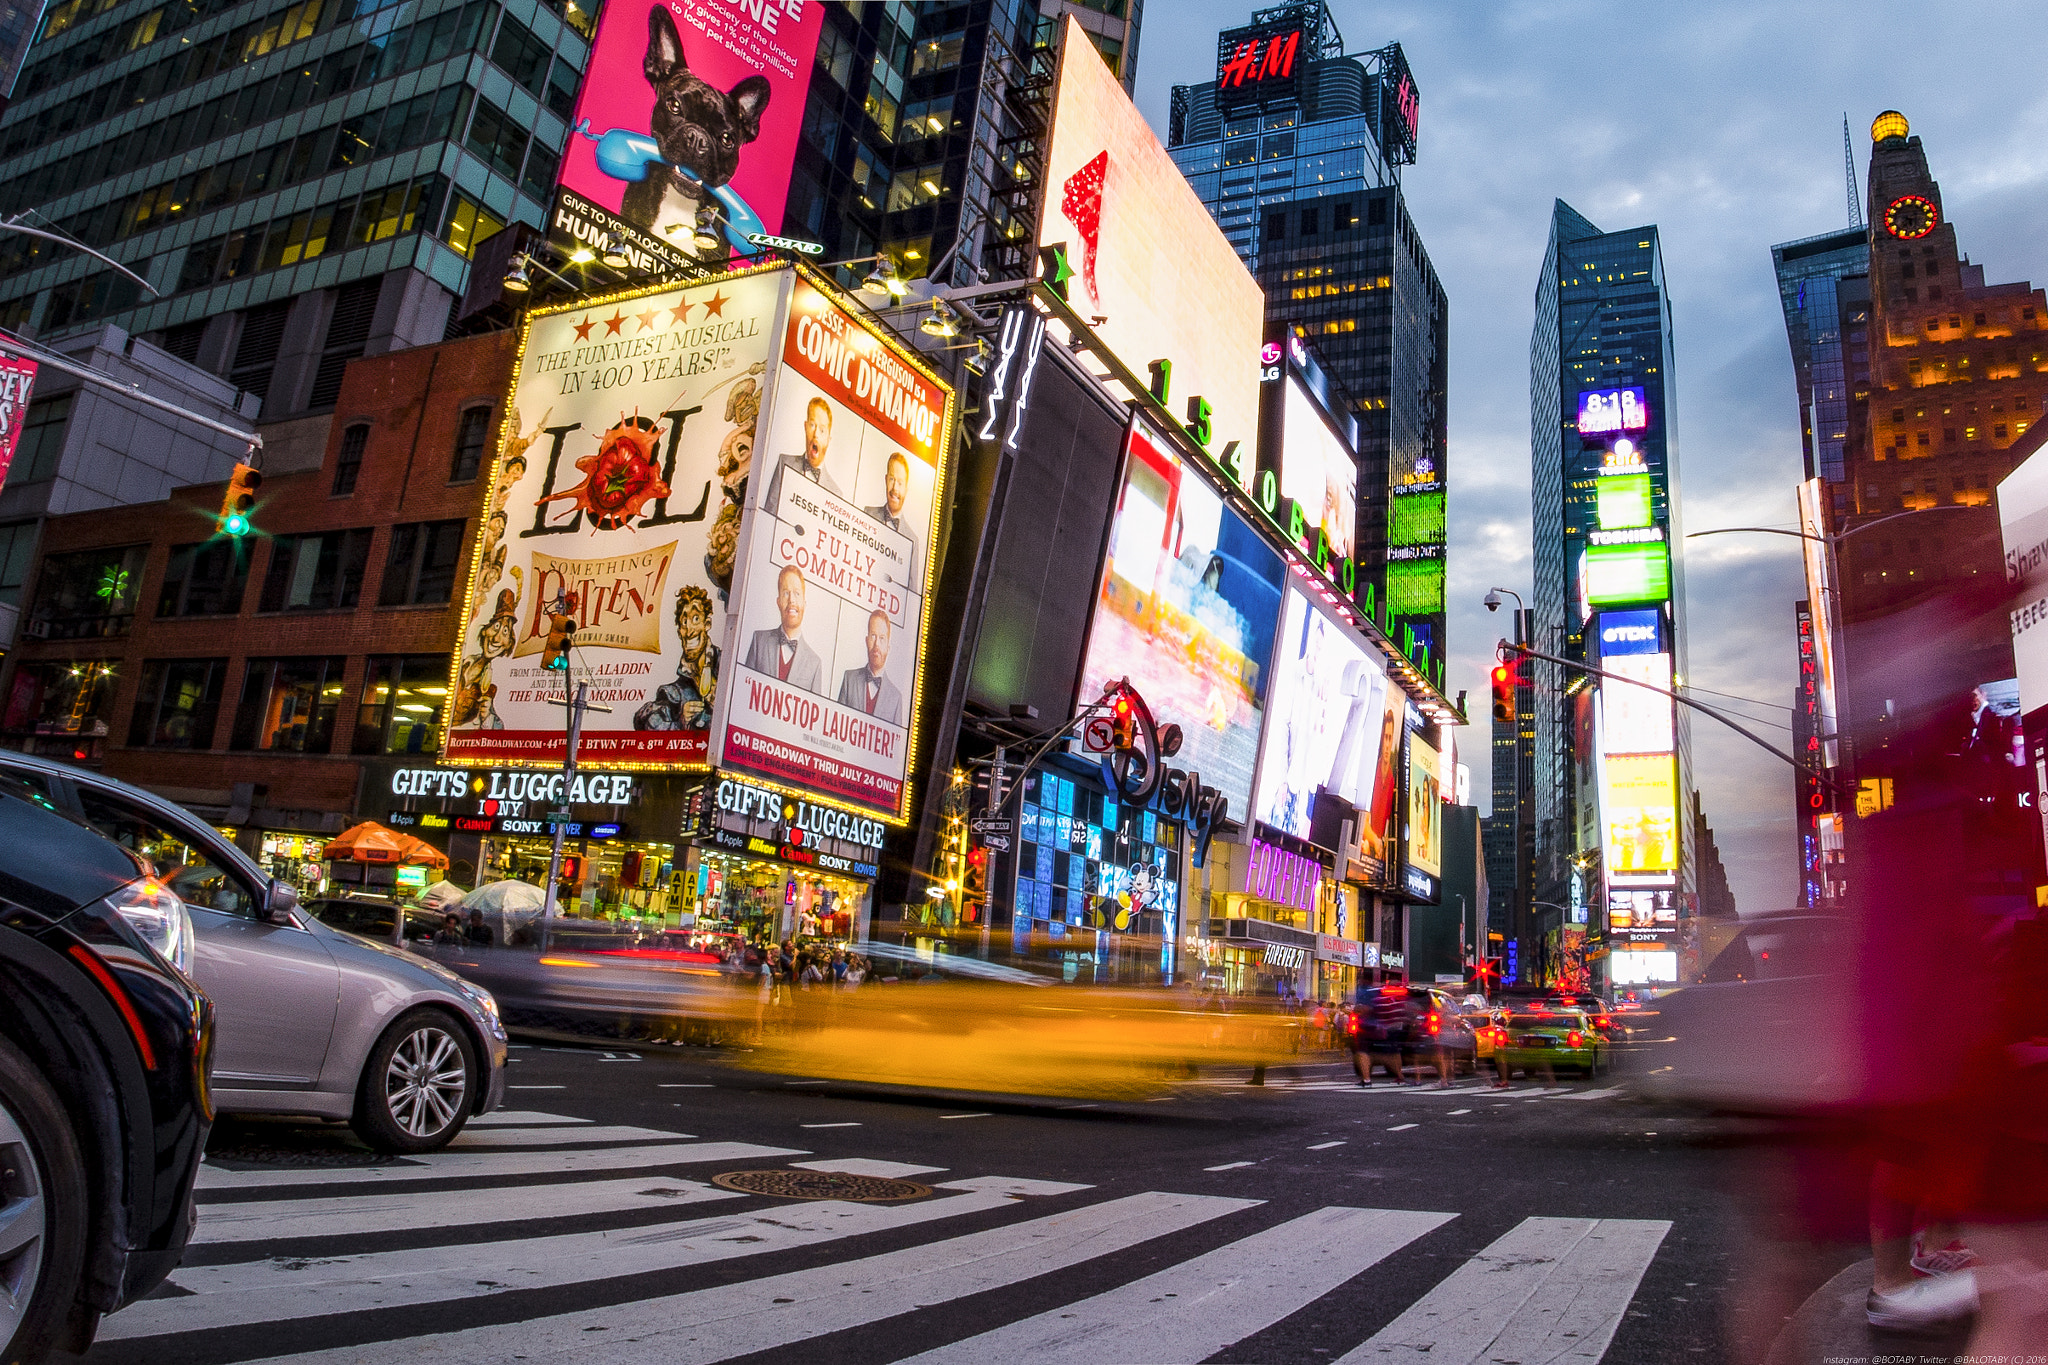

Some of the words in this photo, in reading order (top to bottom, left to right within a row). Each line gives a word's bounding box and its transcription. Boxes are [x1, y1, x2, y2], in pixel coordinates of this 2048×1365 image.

[725, 0, 780, 36] NE
[671, 1, 682, 14] to
[684, 9, 706, 31] local
[706, 28, 723, 45] pet
[725, 38, 765, 72] shelters?
[696, 6, 721, 27] gives
[724, 22, 737, 39] 1%
[739, 36, 750, 46] of
[750, 41, 761, 55] its
[762, 50, 794, 80] millions
[741, 23, 752, 33] of
[753, 30, 768, 45] the
[769, 40, 798, 67] United
[1221, 31, 1300, 88] H&M
[562, 193, 588, 216] GIVE
[590, 207, 606, 224] TO
[637, 233, 670, 260] LOCAL
[752, 234, 819, 254] LAMAR
[535, 351, 571, 374] THE
[573, 334, 667, 367] FUNNIEST
[670, 317, 760, 351] MUSICAL
[796, 315, 856, 389] COMIC
[816, 309, 844, 337] JESSE
[871, 347, 915, 393] FERGUSON
[914, 384, 921, 398] IS
[921, 389, 927, 402] A
[559, 370, 585, 395] IN
[591, 365, 633, 391] 400
[1260, 366, 1280, 381] LG
[1586, 389, 1636, 413] 8:18
[1605, 451, 1641, 467] 2016
[789, 492, 819, 517] JESSE
[821, 509, 850, 535] TYLER
[851, 527, 898, 562] FERGUSON
[824, 500, 851, 521] MODERN
[816, 529, 876, 577] FULLY
[1590, 527, 1662, 546] TOSHIBA
[550, 552, 653, 576] SOMETHING
[780, 538, 901, 616] COMMITTED
[521, 555, 670, 644] RTTEN!
[1615, 626, 1656, 642] TDK
[509, 668, 530, 678] FROM
[531, 667, 546, 678] THE
[547, 666, 584, 677] DIRETOR
[595, 662, 652, 676] ALADDIN
[530, 679, 547, 689] AND
[548, 679, 563, 689] THE
[613, 678, 624, 687] OF
[1802, 620, 1815, 715] ERNST
[508, 690, 533, 702] THE
[534, 690, 567, 702] BOOK
[588, 689, 647, 701] MORMON
[585, 739, 617, 750] BTWN
[621, 739, 637, 750] 7TH
[638, 741, 645, 750] &
[647, 739, 664, 750] 8TH
[667, 739, 694, 750] AVES.
[1807, 735, 1819, 751] &
[730, 747, 763, 765] LIMITED
[764, 757, 816, 781] ENGAGEMENT
[732, 731, 750, 748] ON
[751, 738, 811, 767] BROADWAY
[813, 757, 839, 776] THRU
[840, 767, 863, 783] JULY
[863, 772, 875, 786] 24
[876, 778, 899, 795] ONLY
[391, 769, 469, 798] GIFTS
[487, 771, 632, 805] LUGGAGE
[396, 815, 415, 826] Apple
[420, 814, 449, 829] Nikon
[455, 817, 494, 832] Canon
[502, 819, 542, 833] SONY
[497, 801, 523, 817] NY
[717, 780, 782, 823] GIFTS
[796, 801, 885, 849] LUGGAGE
[723, 834, 743, 848] Apple
[748, 837, 776, 855] Nikon
[780, 846, 813, 865] Canon
[818, 855, 851, 871] SONY
[853, 861, 877, 878] BOWER
[802, 833, 824, 850] NY
[670, 872, 682, 906] ATM
[685, 874, 696, 908] ATM
[1245, 838, 1321, 912] FOREVER
[1629, 933, 1658, 941] SONY
[1263, 943, 1297, 968] FOREVER
